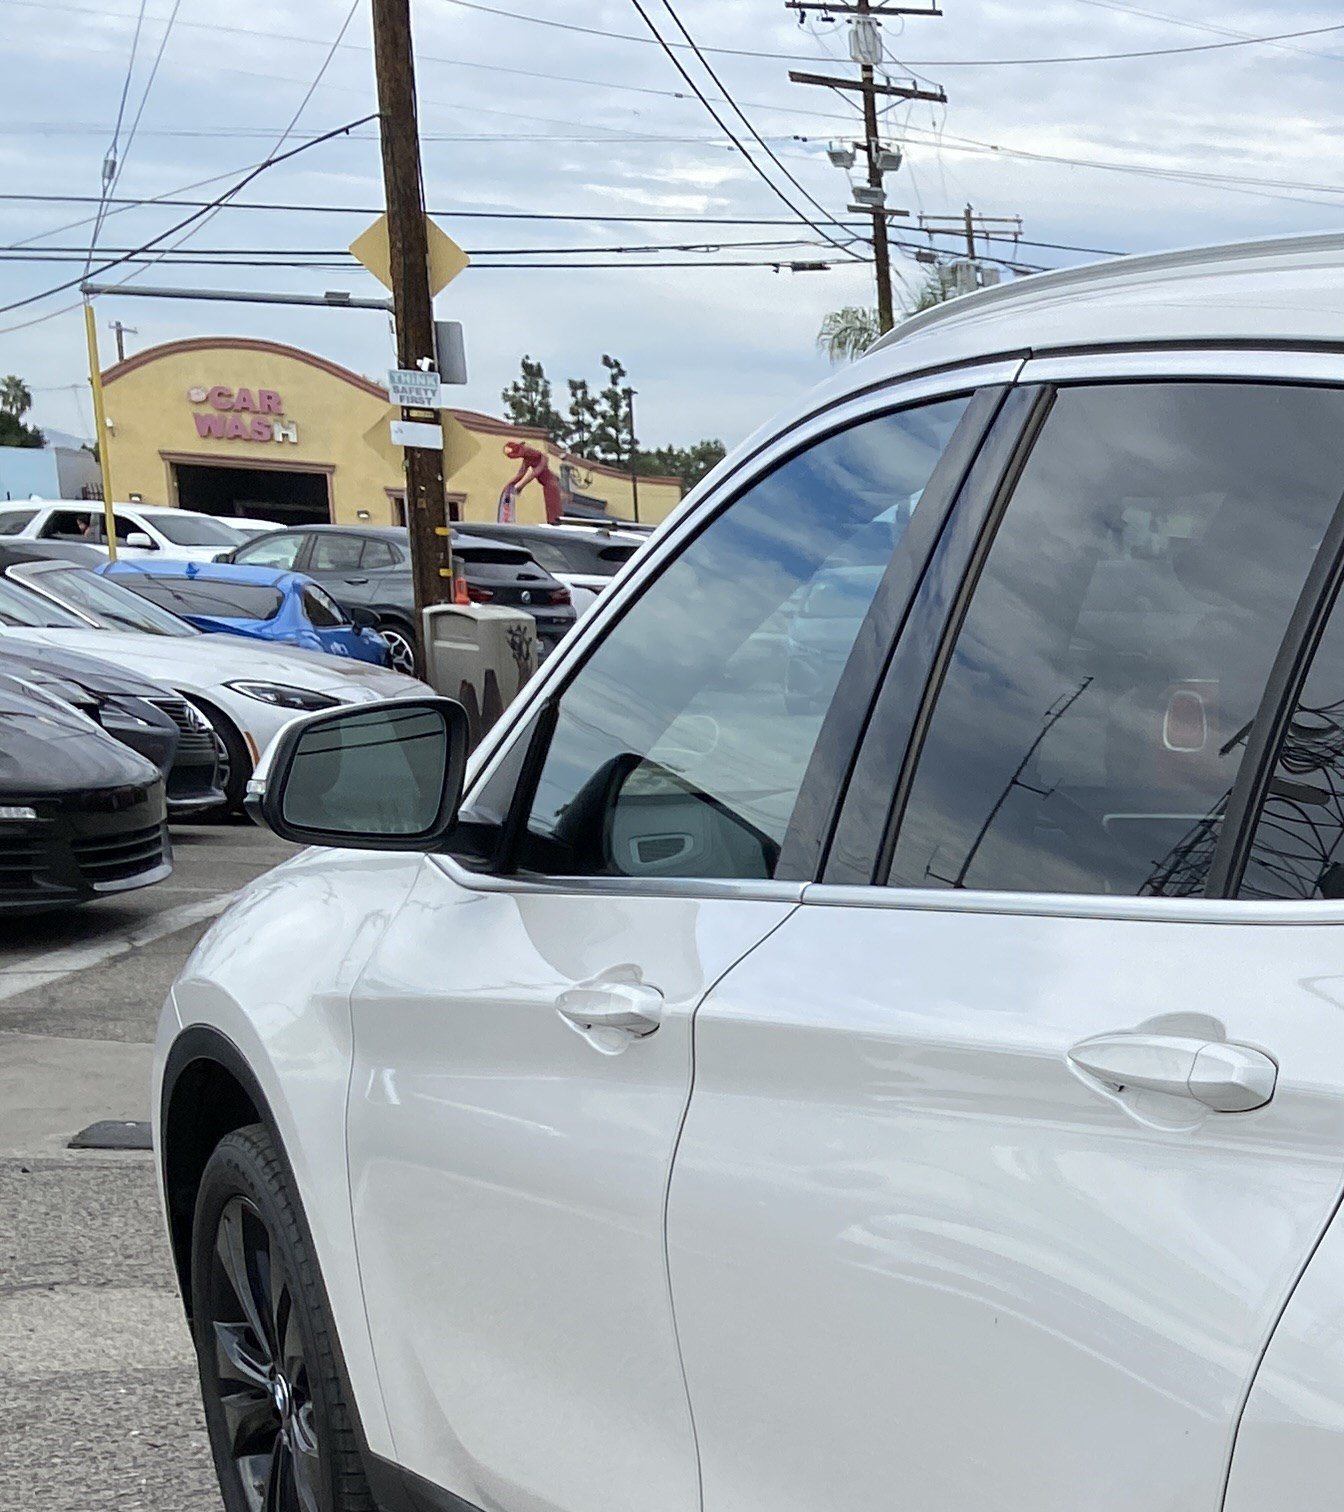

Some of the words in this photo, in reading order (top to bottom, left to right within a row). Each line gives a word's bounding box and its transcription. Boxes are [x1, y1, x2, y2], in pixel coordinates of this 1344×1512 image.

[390, 371, 438, 387] THINK
[392, 385, 437, 397] SAFETY
[207, 385, 284, 415] CAR
[399, 394, 432, 406] FIRST
[193, 412, 298, 444] WASH
